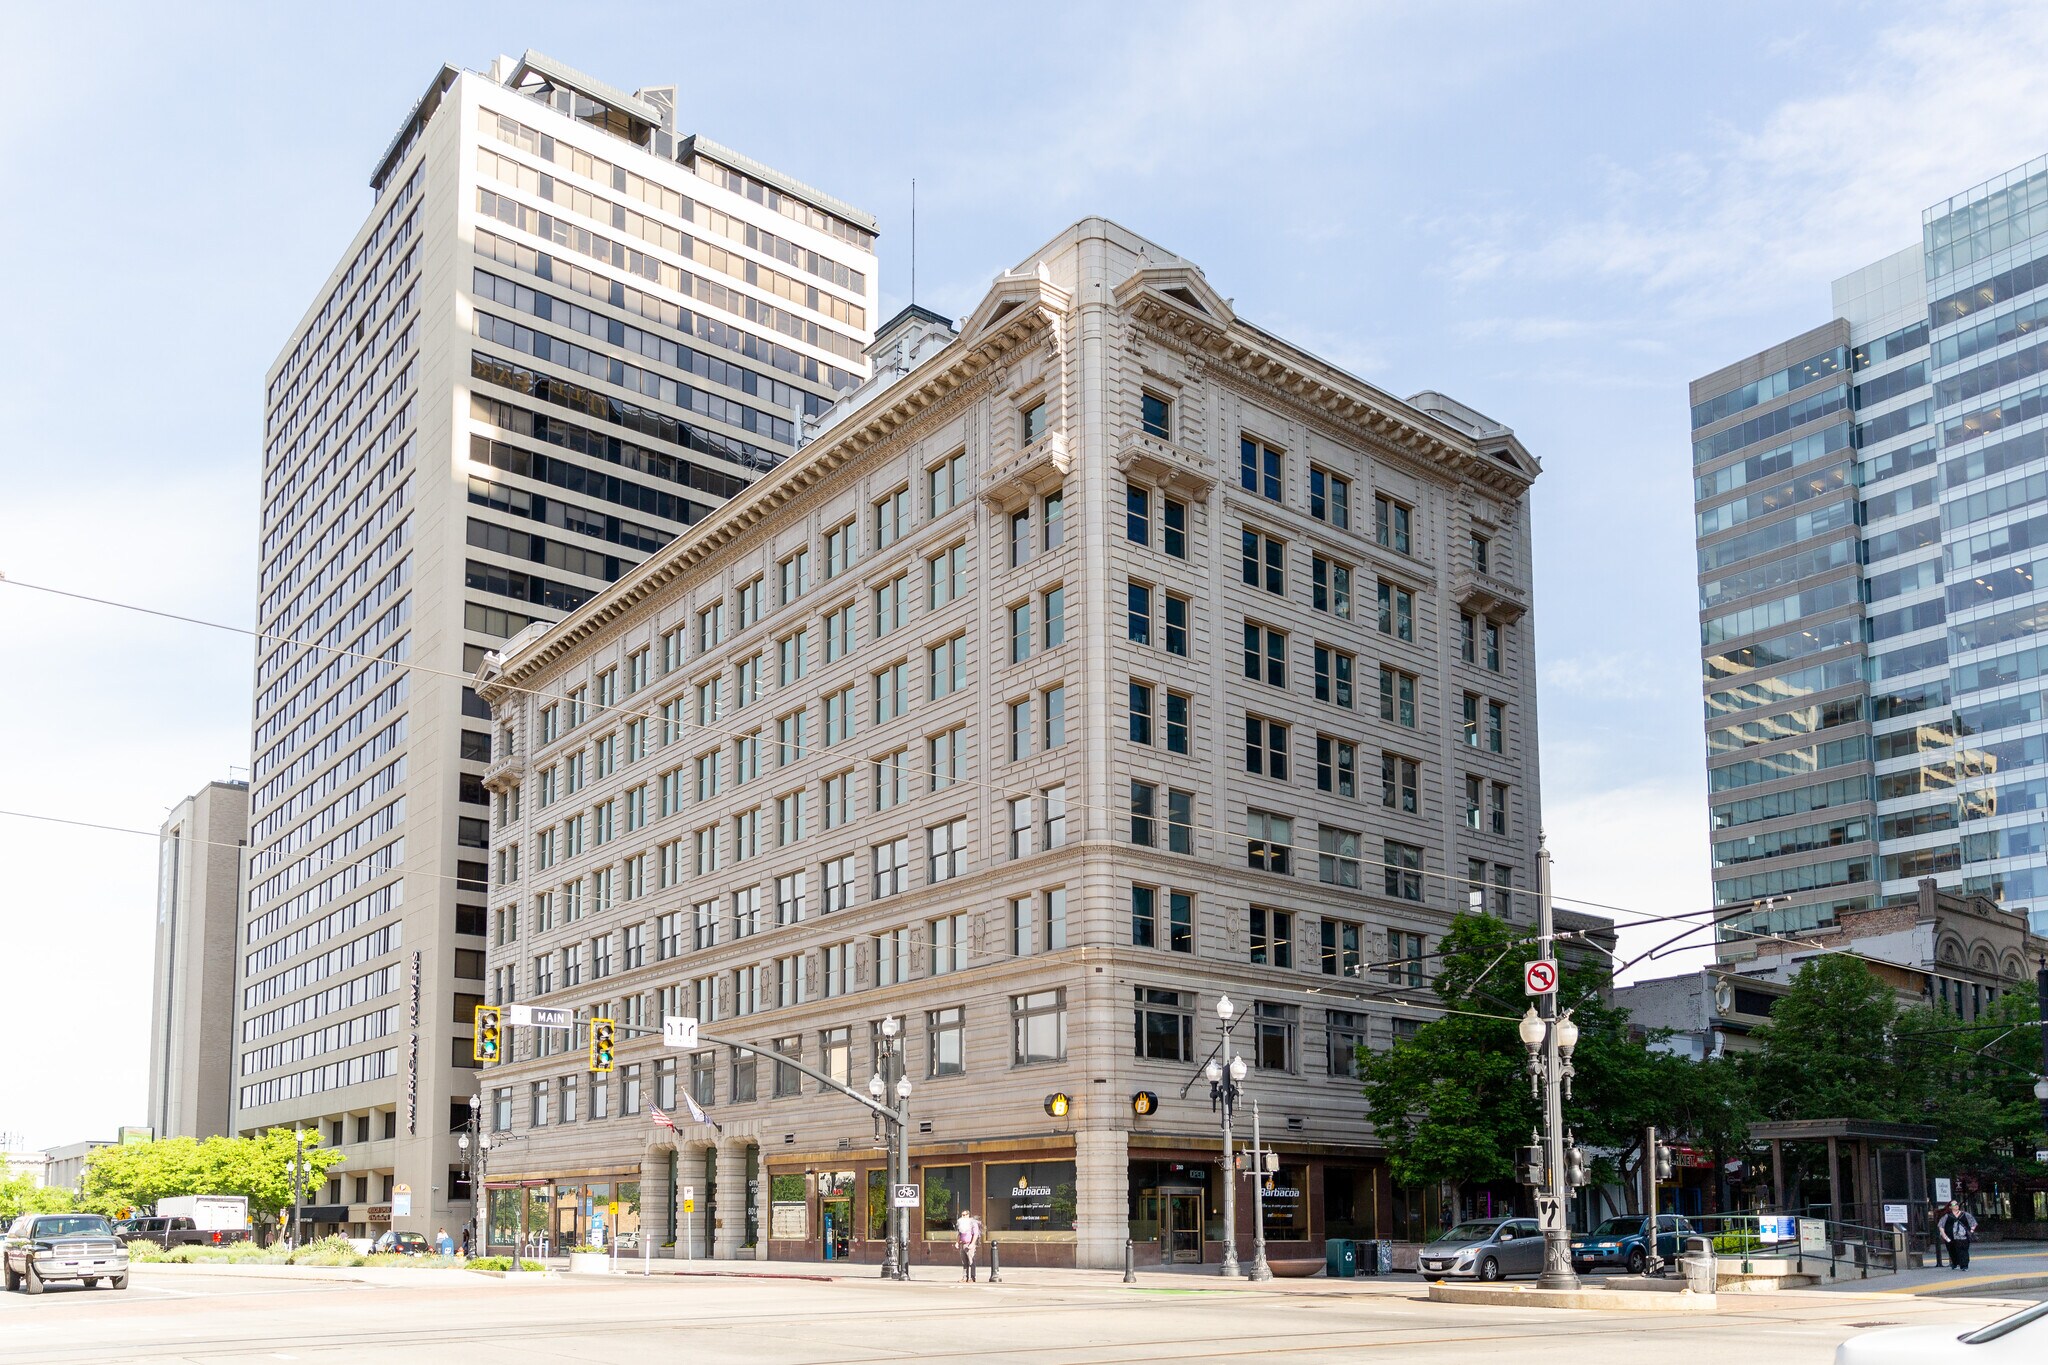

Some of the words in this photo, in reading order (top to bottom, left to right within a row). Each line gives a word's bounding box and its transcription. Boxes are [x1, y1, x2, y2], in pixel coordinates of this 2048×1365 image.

[410, 951, 421, 1029] TOWERS
[537, 1011, 565, 1024] MAIN
[406, 1033, 419, 1135] AMERICAN
[1012, 1187, 1051, 1196] Barbacoa
